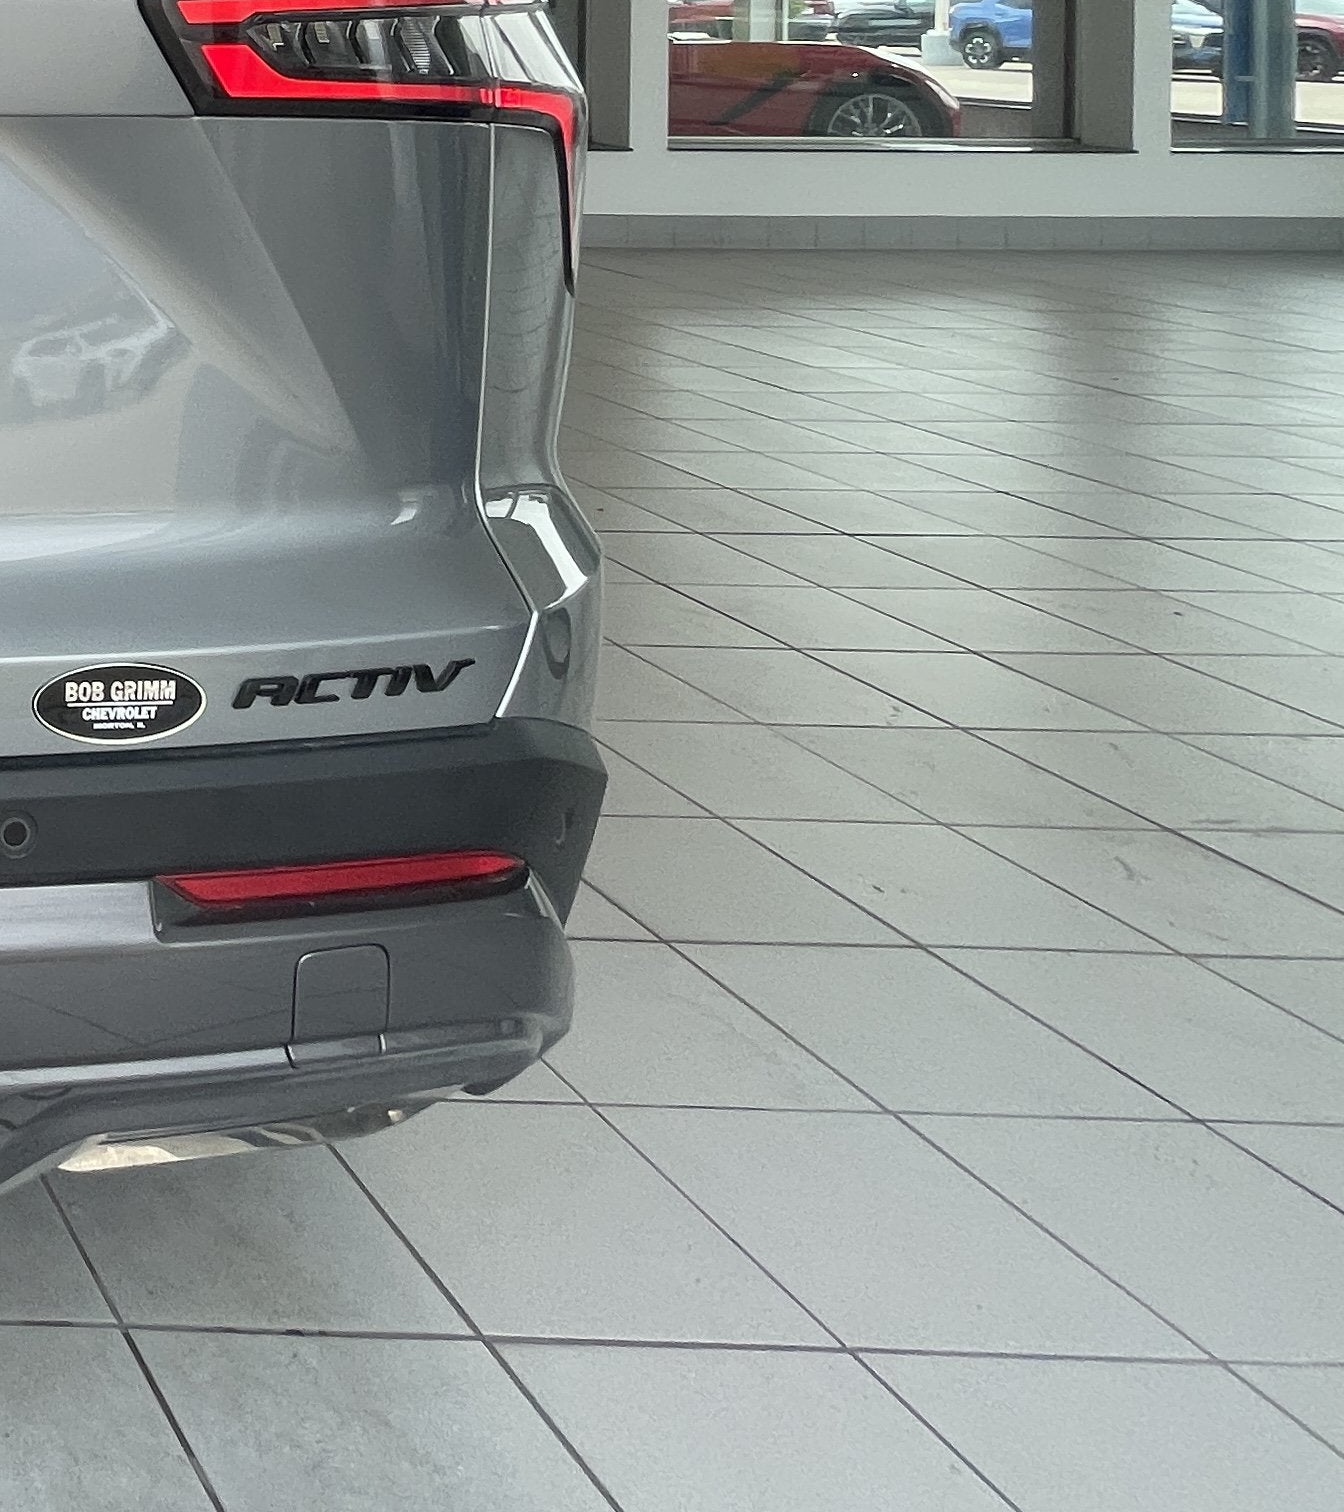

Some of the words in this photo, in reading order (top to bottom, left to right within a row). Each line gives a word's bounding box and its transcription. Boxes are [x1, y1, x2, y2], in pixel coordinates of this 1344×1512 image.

[64, 681, 105, 702] BOB
[110, 679, 177, 702] GRIMM
[231, 657, 477, 710] ACTIV
[81, 706, 158, 721] CHEVROLET
